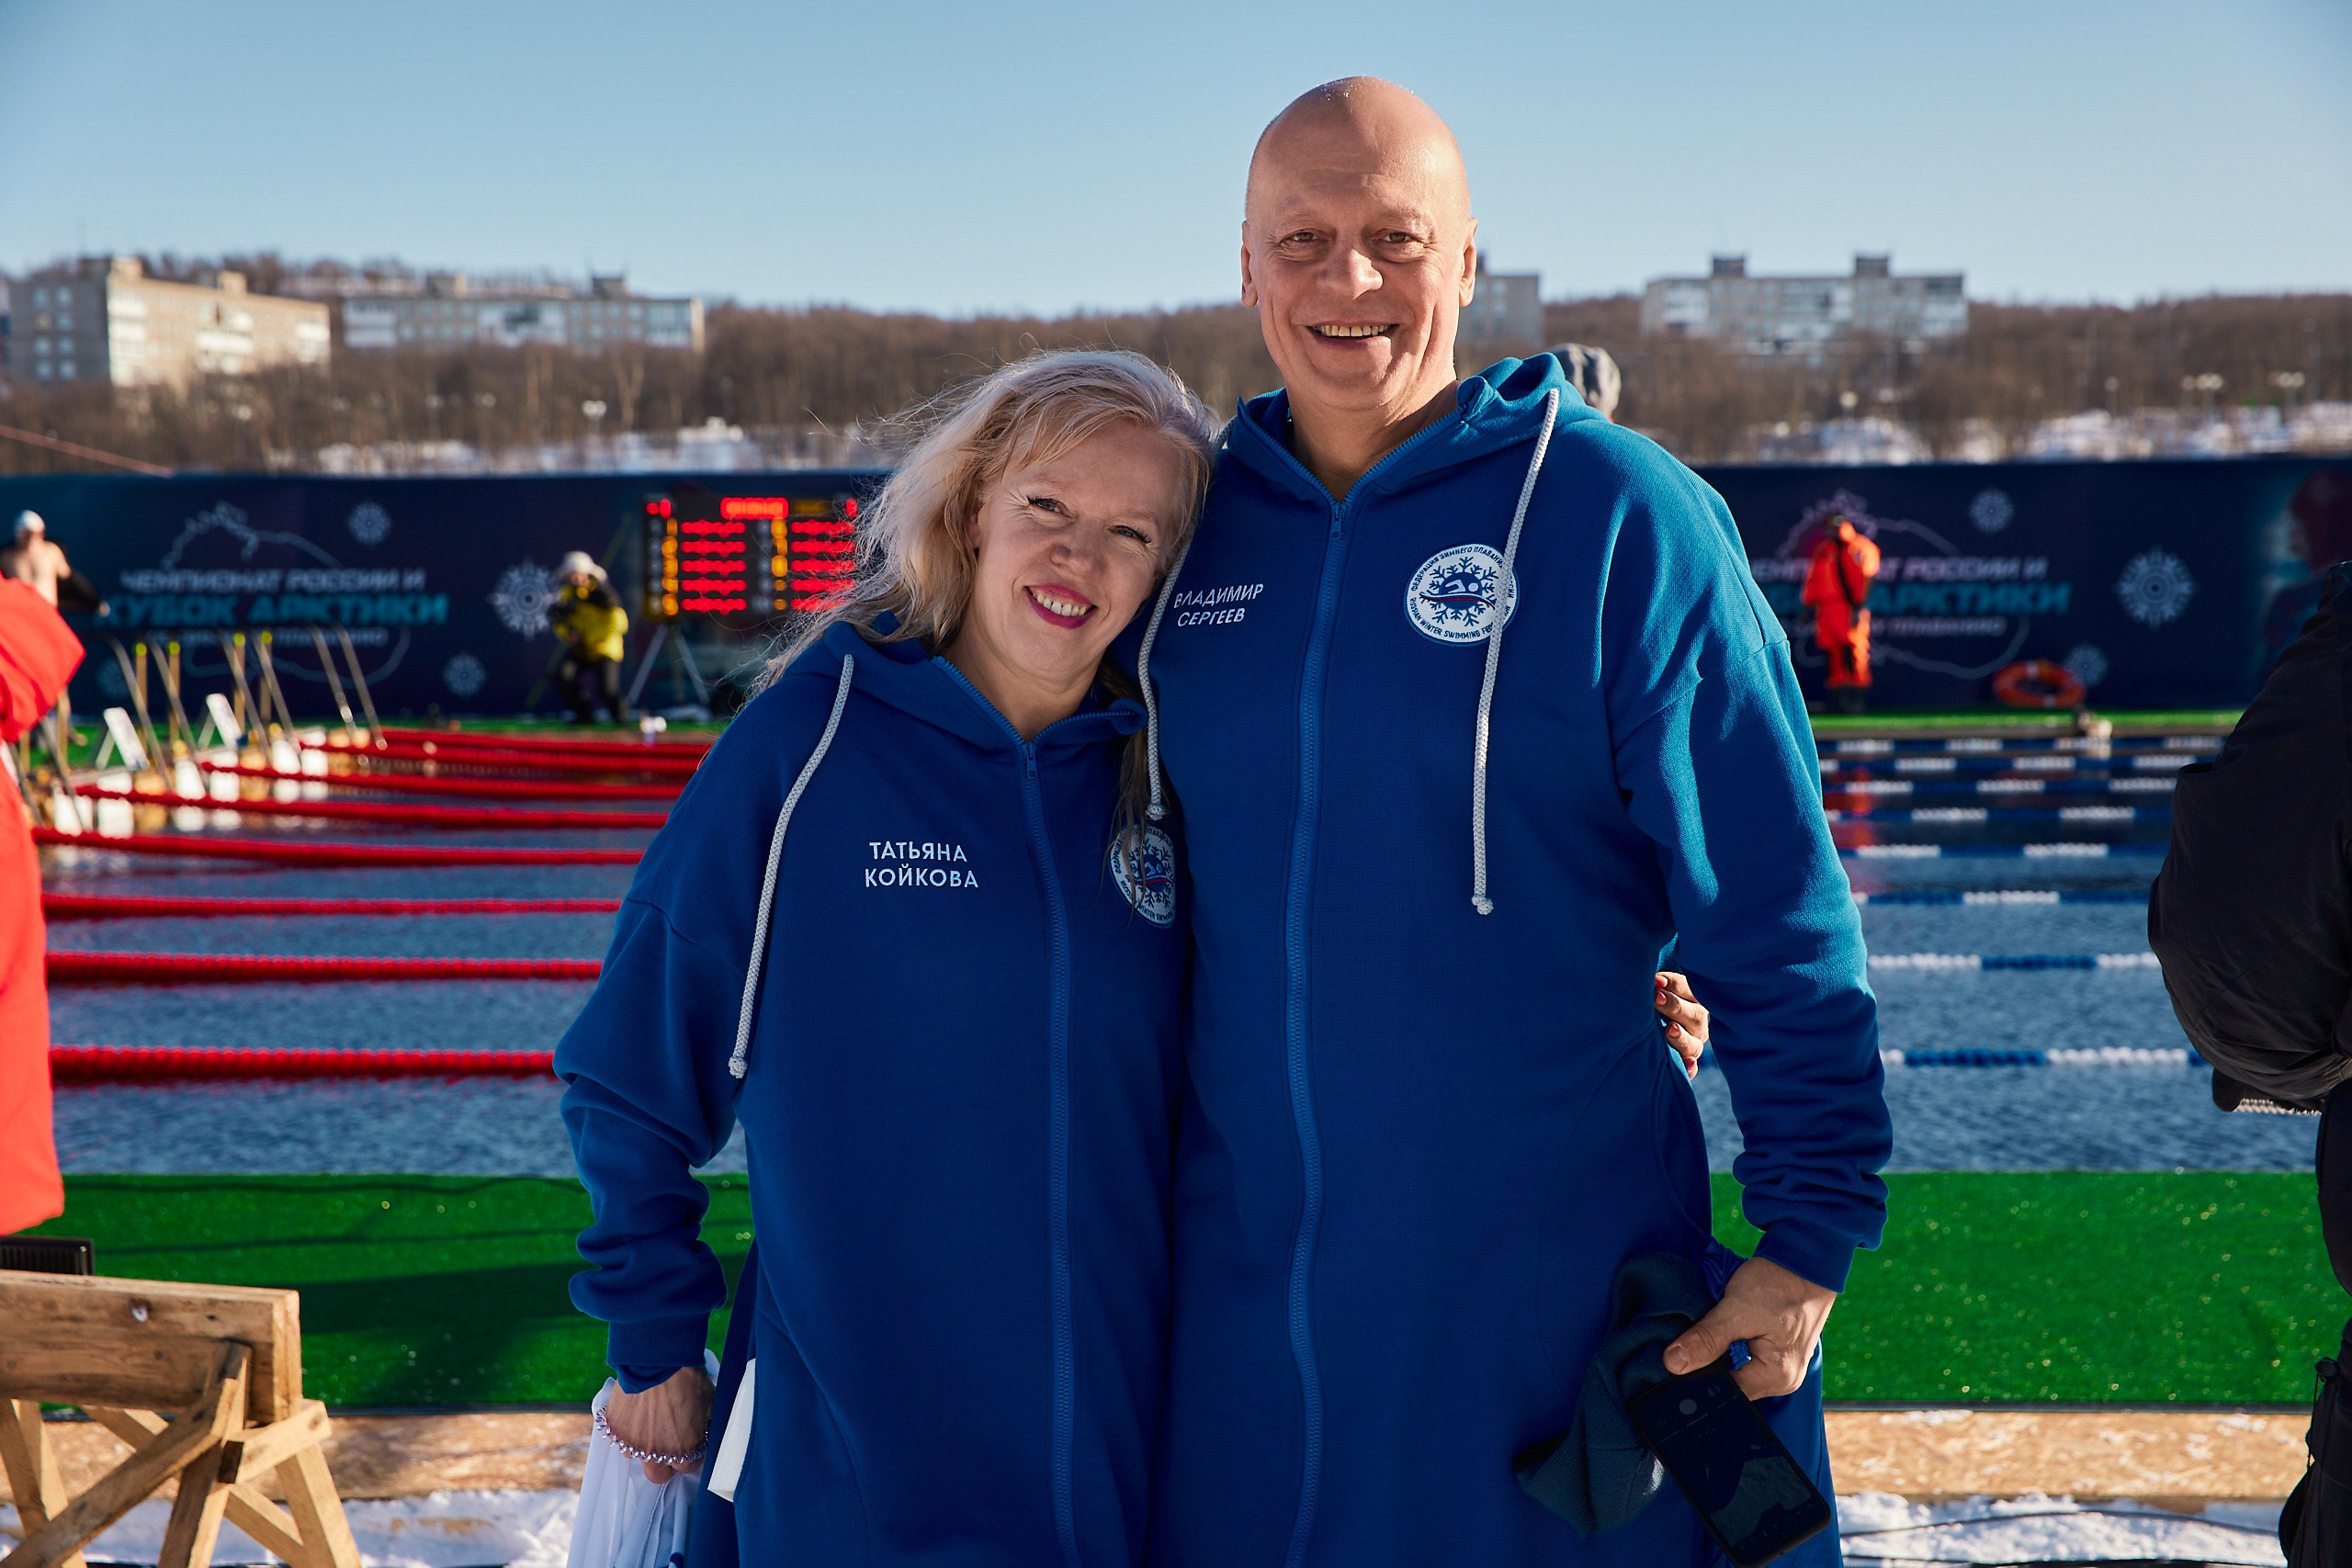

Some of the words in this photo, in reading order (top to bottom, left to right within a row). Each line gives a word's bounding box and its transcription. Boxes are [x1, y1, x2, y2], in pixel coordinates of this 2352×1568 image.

[1410, 557, 1440, 592] ФЕДЕРАЦИЯ
[1439, 547, 1473, 559] ЗИМНЕГО
[1174, 583, 1264, 608] ВЛАДИМИР
[1177, 607, 1246, 626] СЕРГЕЕВ
[1410, 597, 1422, 621] RUSSIAN
[1419, 619, 1442, 636] WINTER
[1443, 630, 1481, 639] SWIMMING
[868, 840, 967, 863] ТАТЬЯНА
[865, 863, 978, 888] КОЙКОВА
